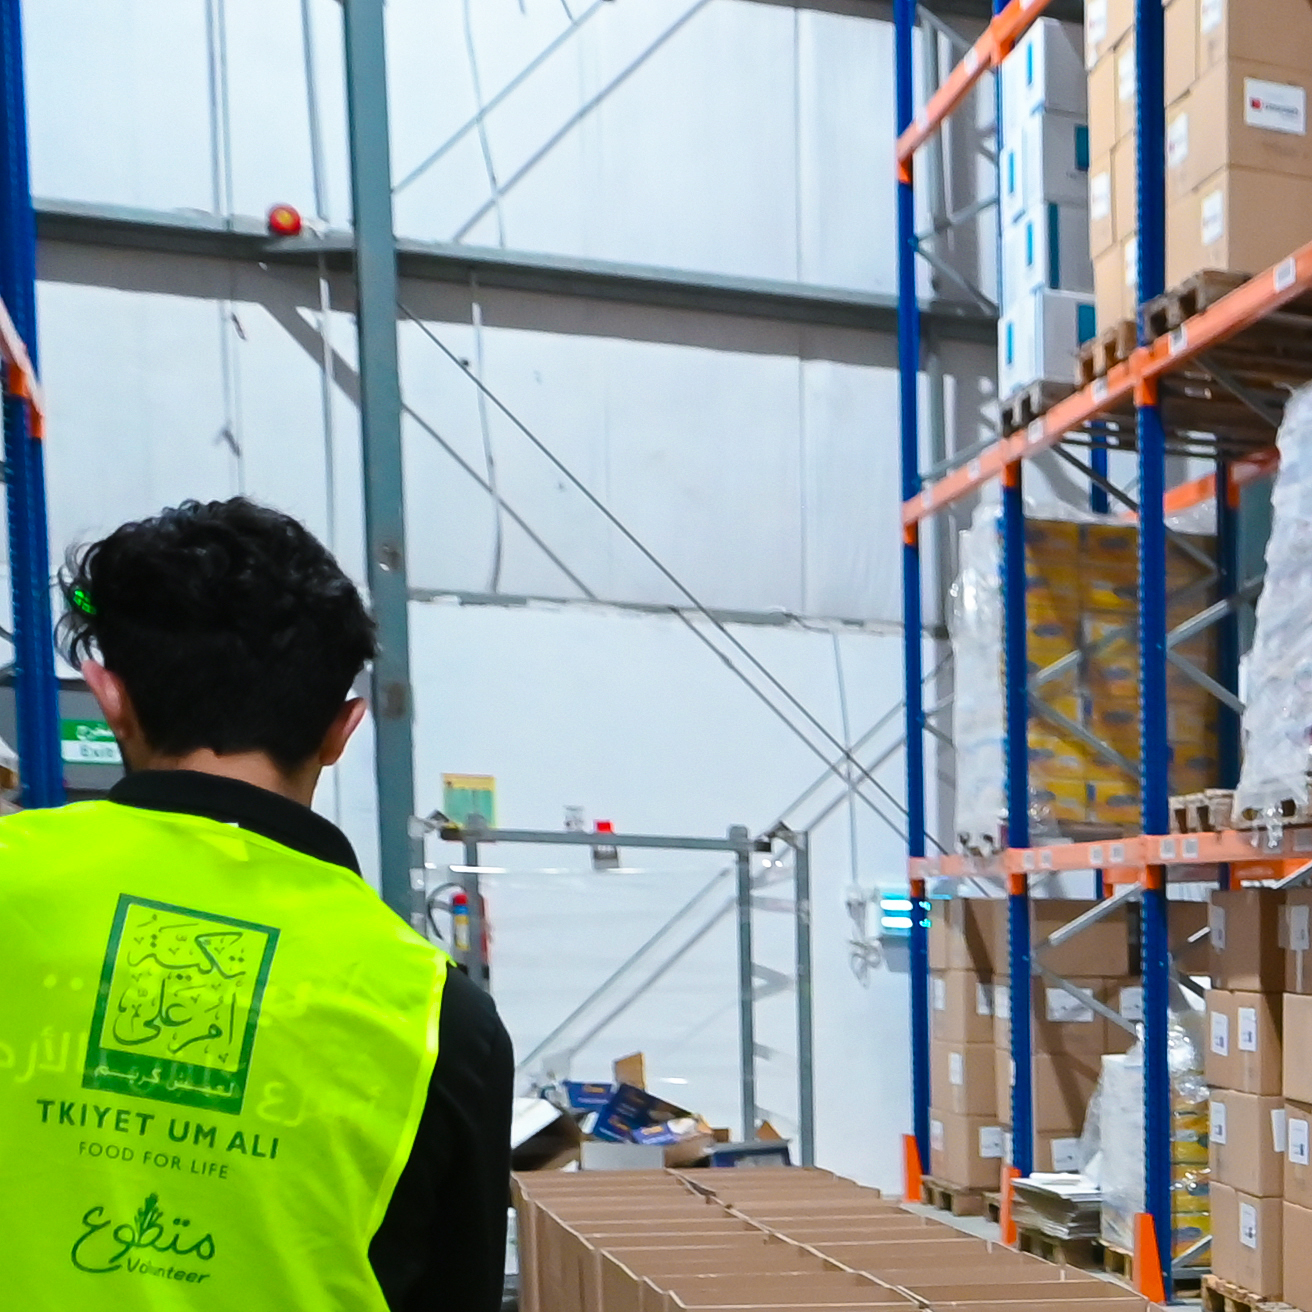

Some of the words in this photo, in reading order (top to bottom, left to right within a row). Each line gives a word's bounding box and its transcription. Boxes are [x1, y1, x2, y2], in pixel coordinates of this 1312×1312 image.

[37, 1098, 155, 1136] TKIYET
[168, 1118, 217, 1148] UM
[226, 1131, 280, 1160] ALI
[79, 1141, 134, 1162] FOOD
[143, 1150, 182, 1171] FOR
[190, 1159, 229, 1180] LIFE
[127, 1257, 211, 1285] Vonteer
